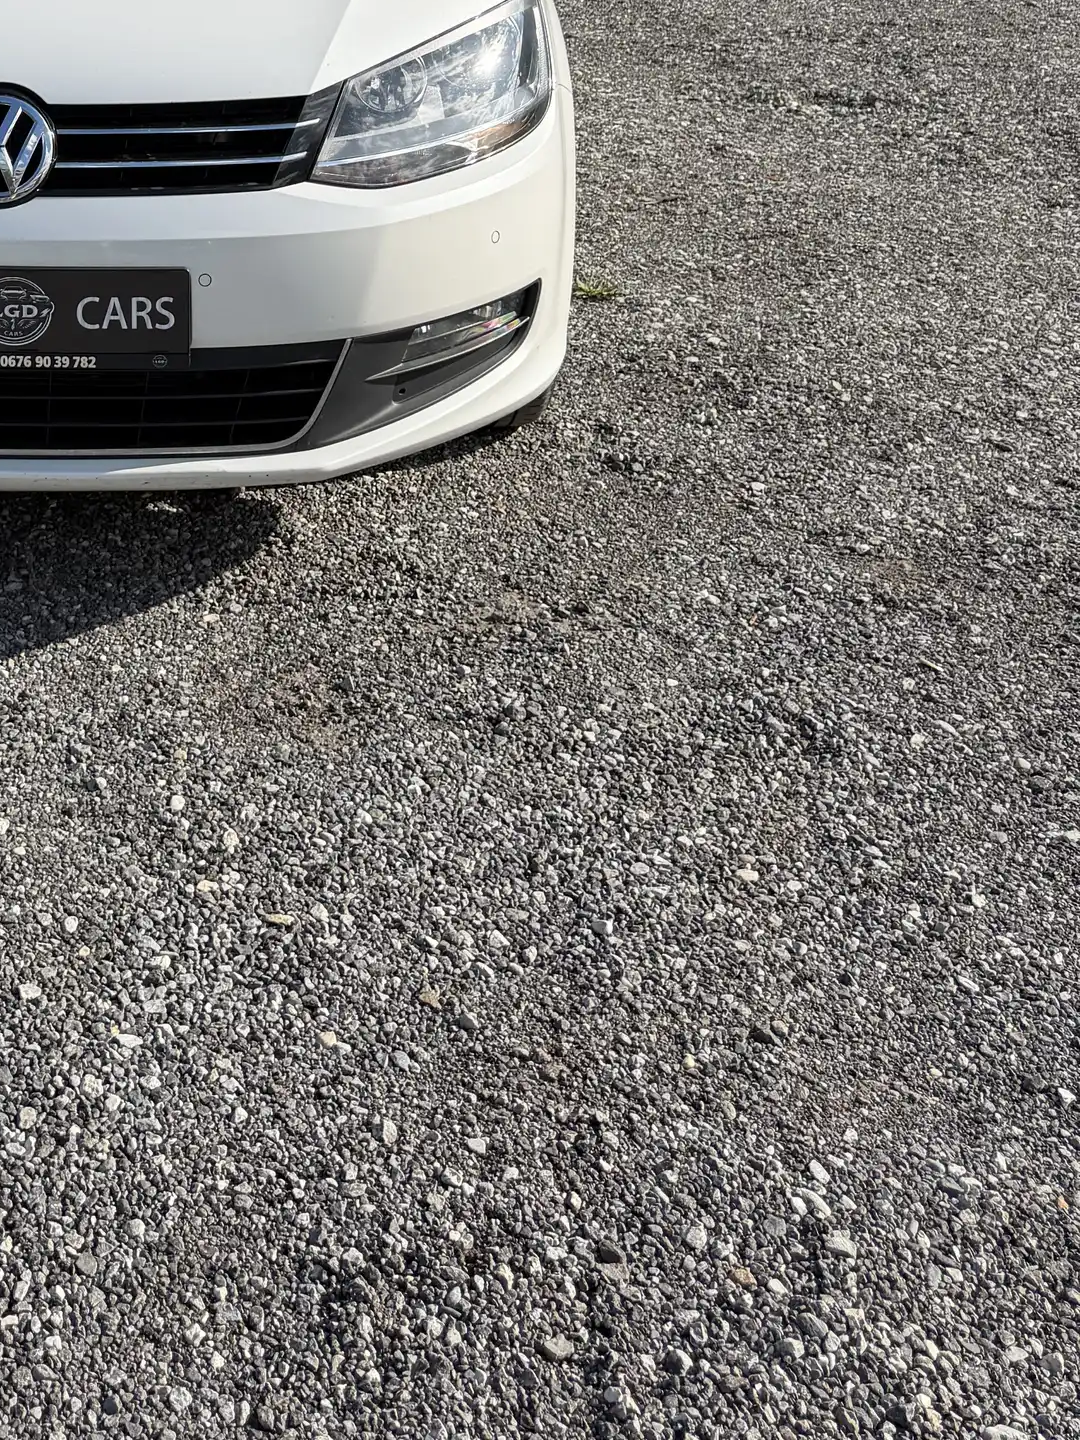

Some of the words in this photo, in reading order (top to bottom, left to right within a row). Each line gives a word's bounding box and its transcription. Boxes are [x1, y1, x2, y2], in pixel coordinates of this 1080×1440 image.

[76, 296, 175, 330] CARS
[0, 355, 32, 368] 0676
[35, 356, 52, 368] 90
[54, 356, 70, 369] 39
[73, 356, 96, 369] 782
